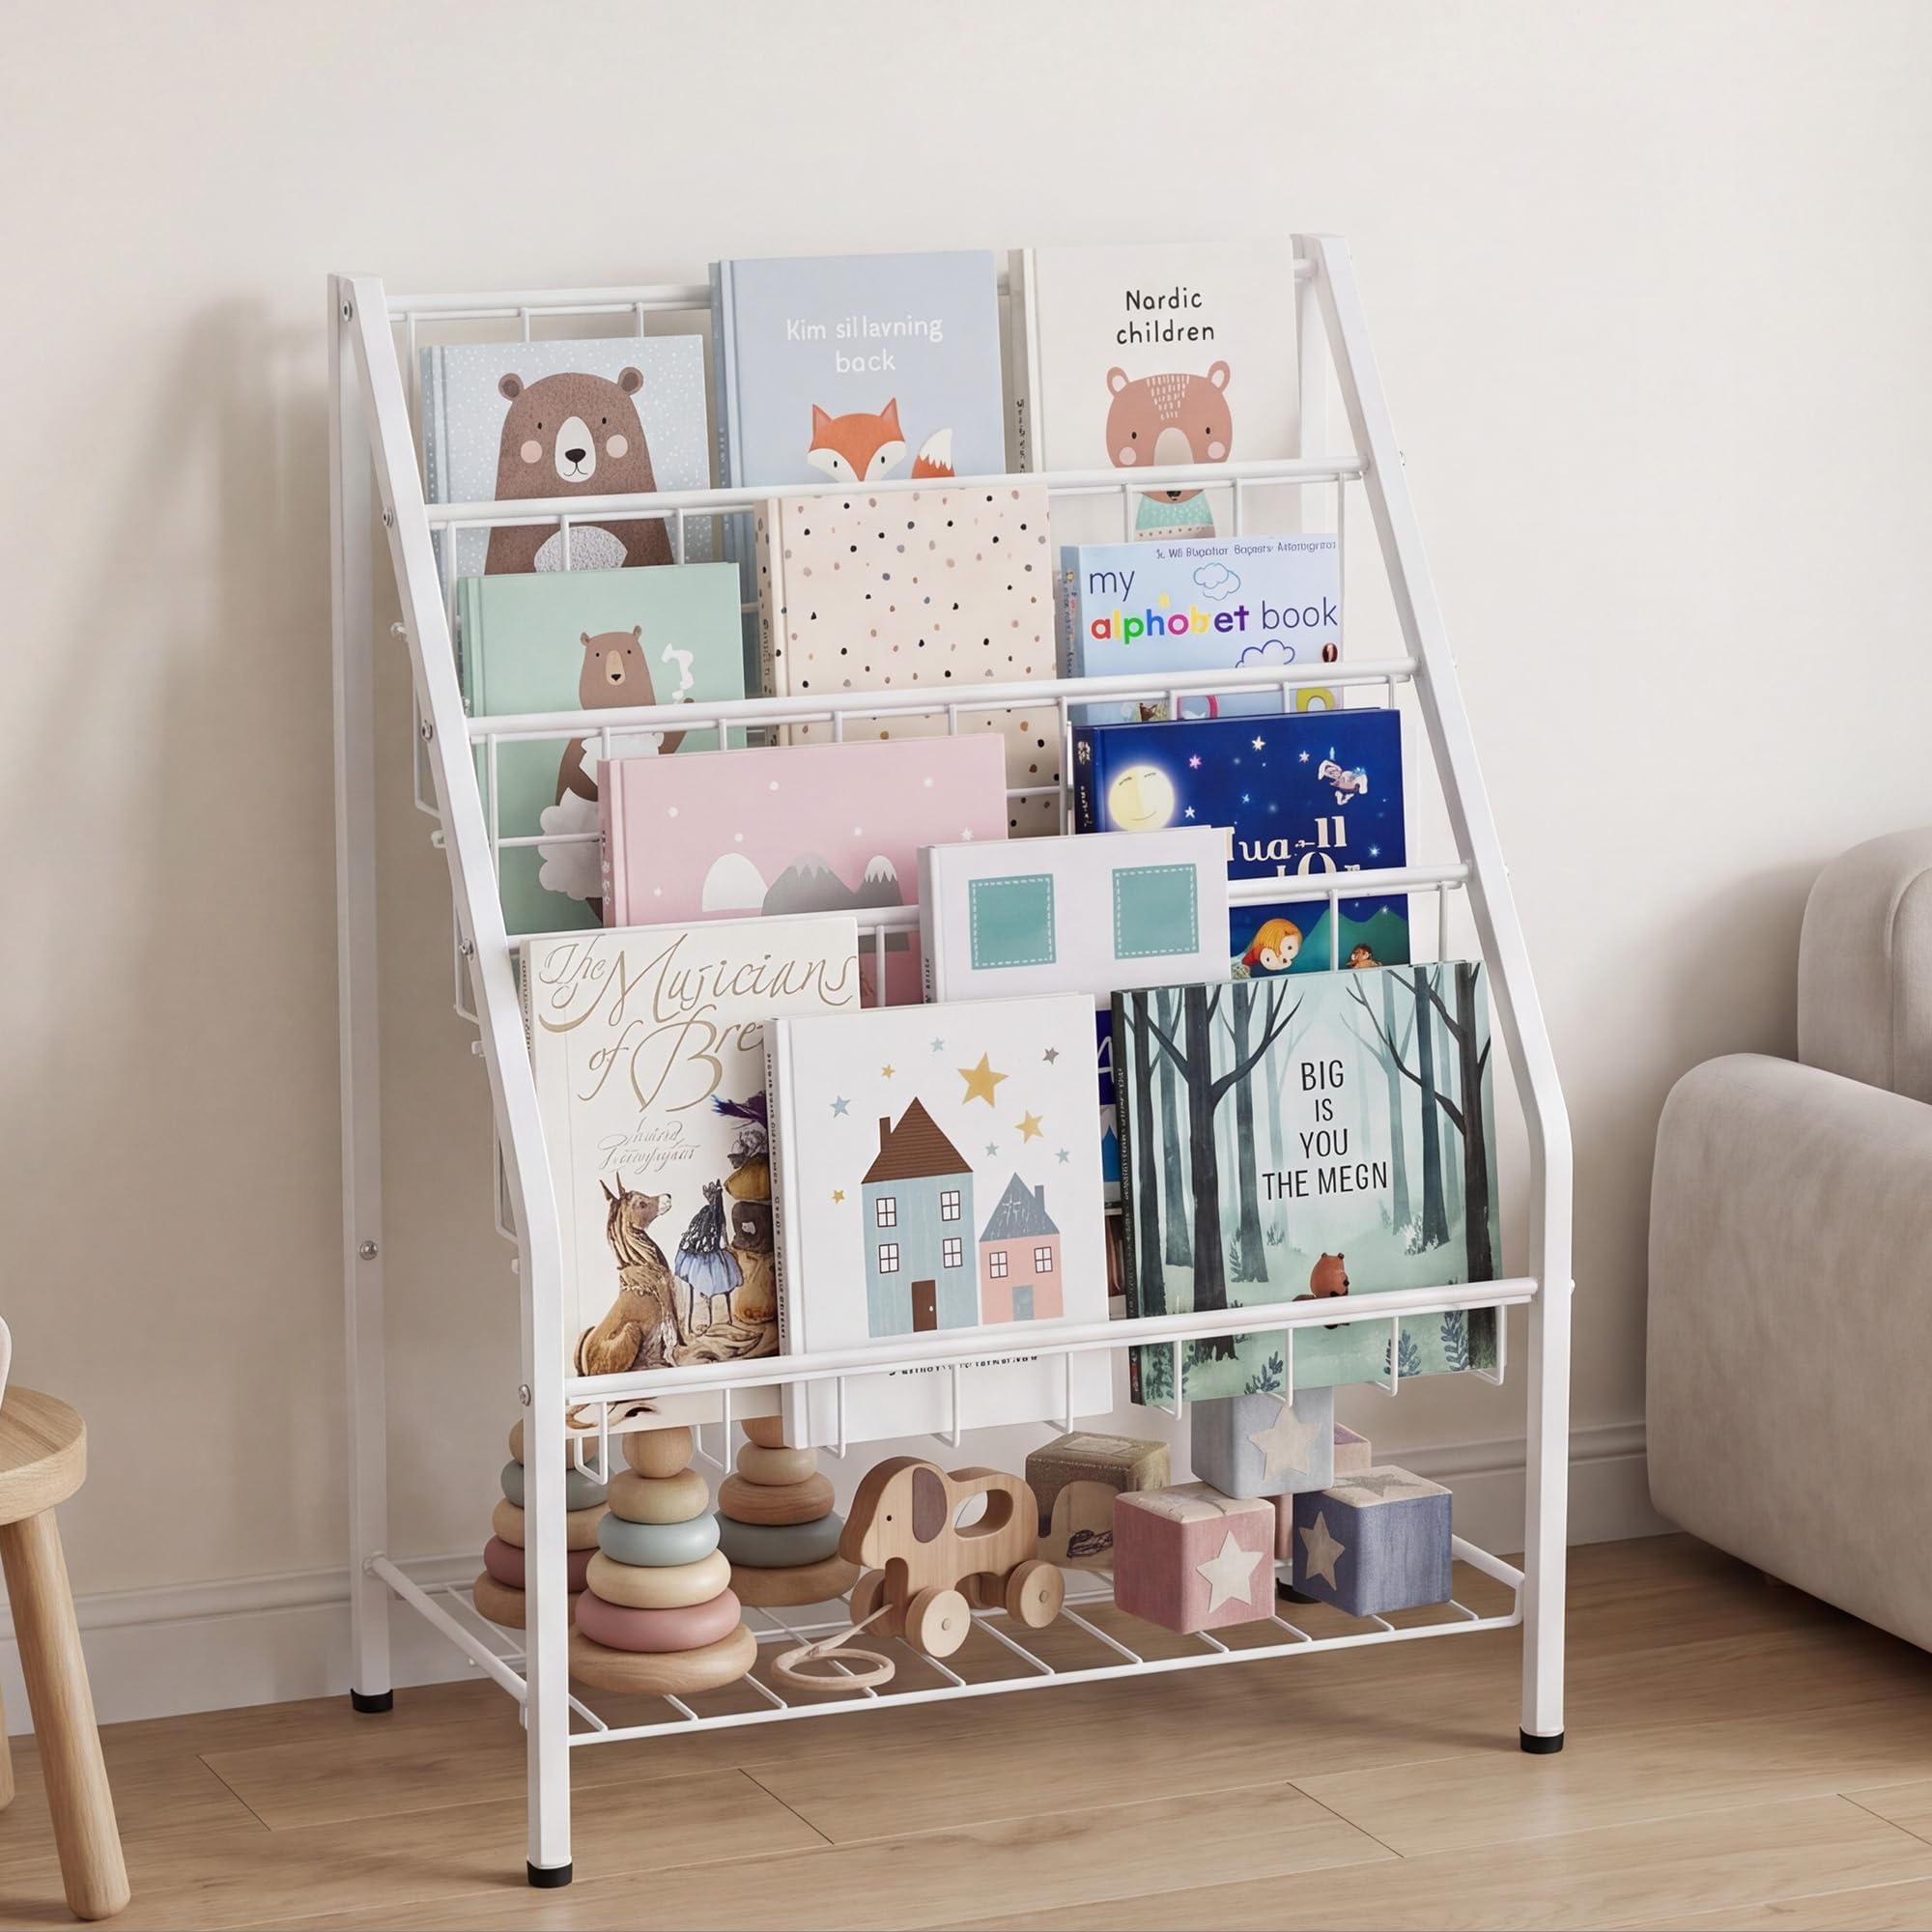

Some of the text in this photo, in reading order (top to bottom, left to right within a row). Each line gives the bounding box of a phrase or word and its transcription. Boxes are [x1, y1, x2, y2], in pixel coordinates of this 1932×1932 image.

[786, 319, 827, 341] Kim
[1117, 319, 1214, 344] children
[1089, 570, 1135, 602] my
[1263, 597, 1338, 630] book
[578, 1019, 644, 1101] of
[1300, 1059, 1345, 1092] BIG
[1314, 1098, 1334, 1122] IS
[1299, 1127, 1349, 1159] YOU
[1262, 1161, 1388, 1201] THE MEGN
